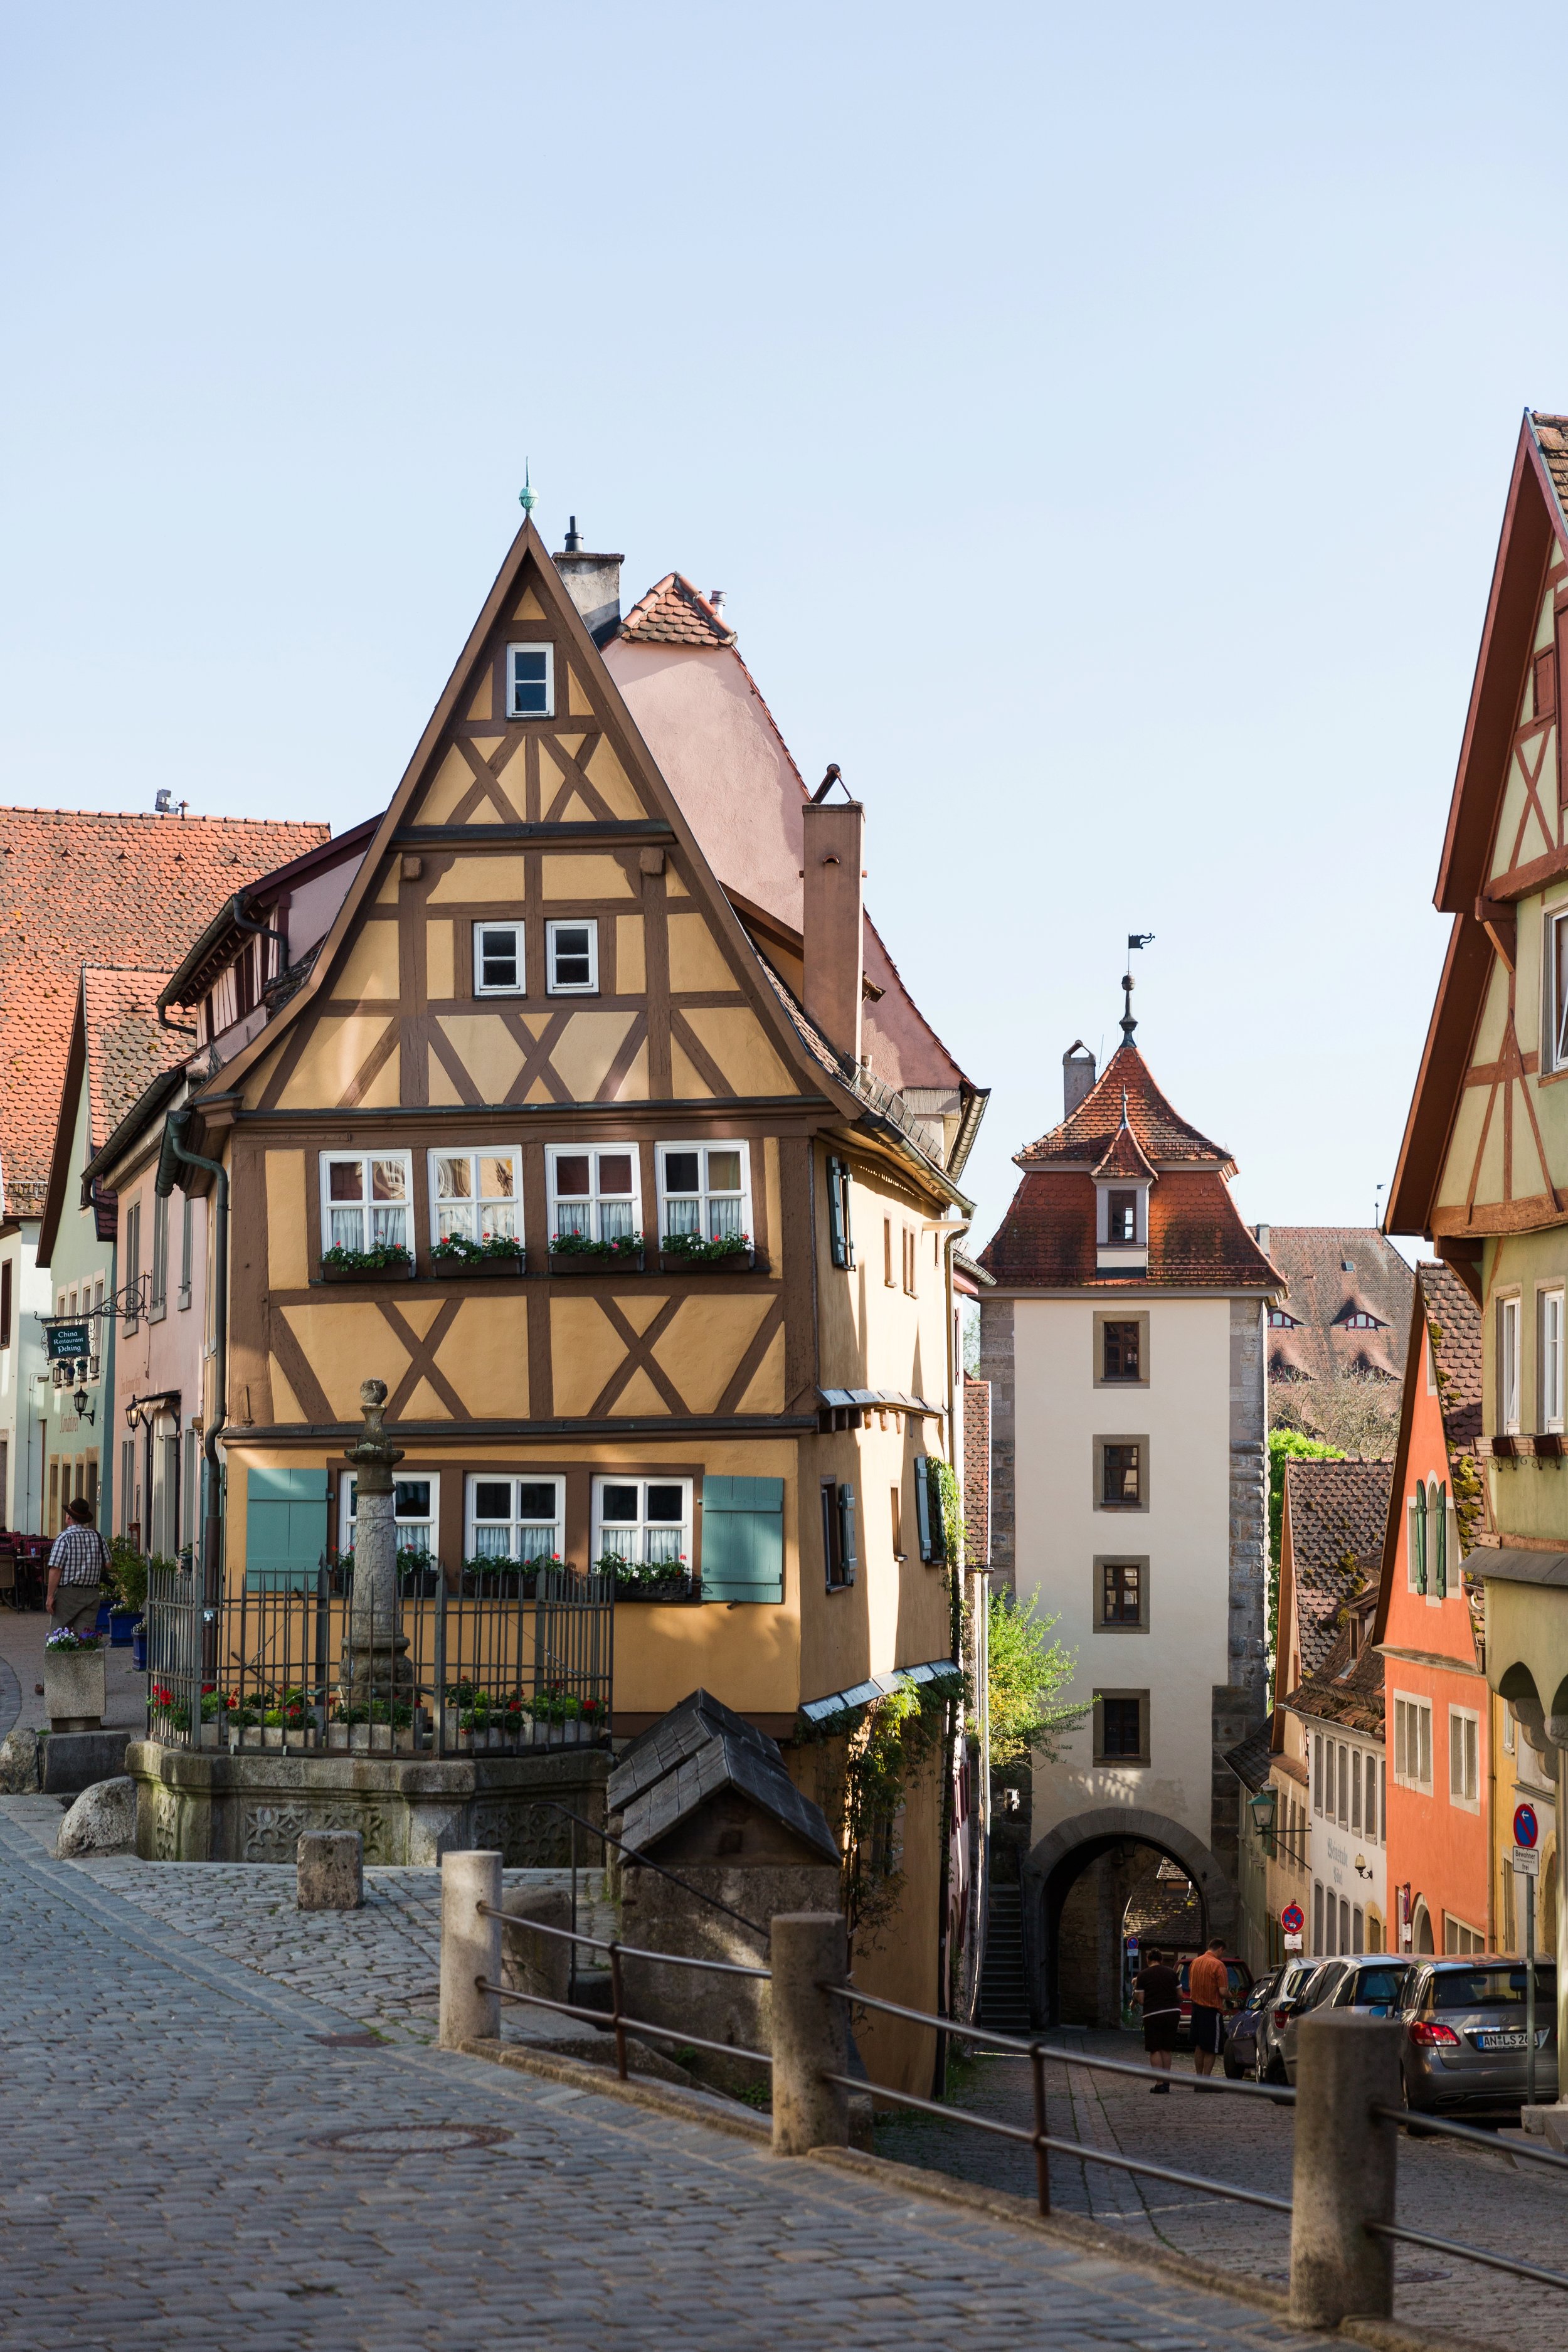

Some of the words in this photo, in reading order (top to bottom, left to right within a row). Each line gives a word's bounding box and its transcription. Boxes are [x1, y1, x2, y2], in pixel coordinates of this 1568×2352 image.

[58, 1345, 82, 1354] Peking
[1515, 1850, 1535, 1860] Bewohner
[1484, 2036, 1497, 2047] AN
[1503, 2035, 1517, 2045] LS
